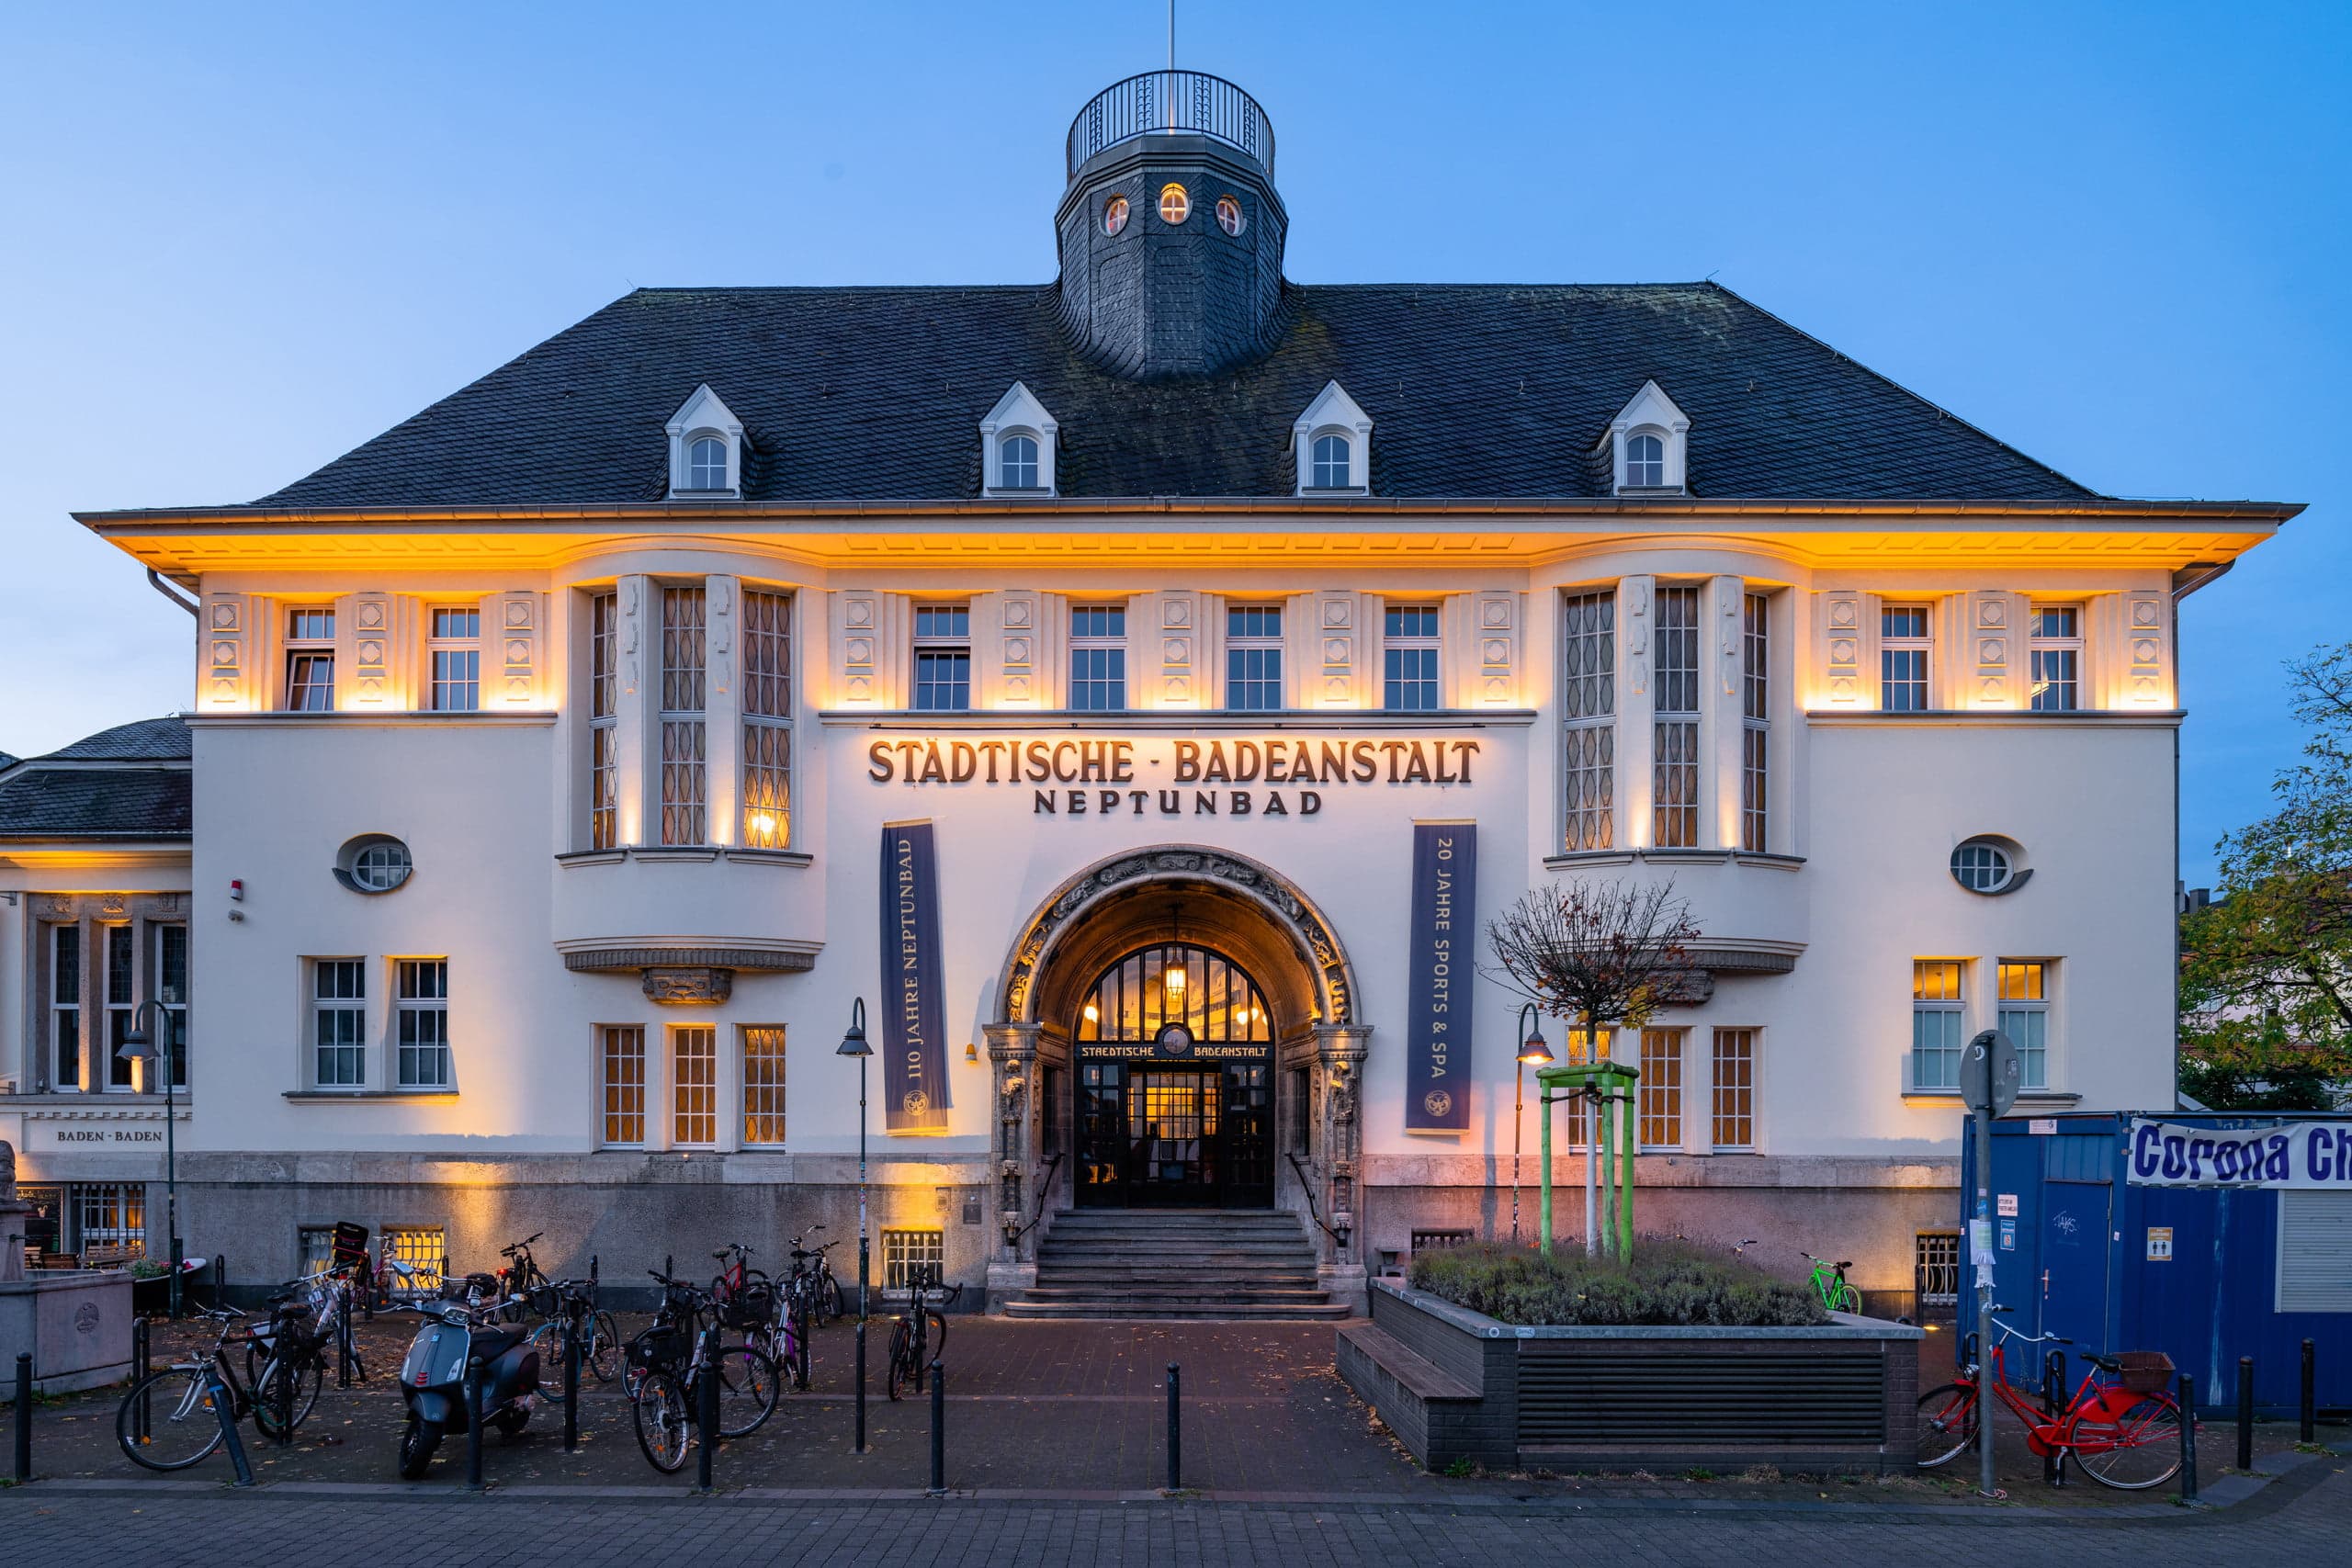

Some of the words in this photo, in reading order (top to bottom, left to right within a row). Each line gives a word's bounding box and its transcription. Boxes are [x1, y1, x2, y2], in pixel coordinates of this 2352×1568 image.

[868, 737, 1134, 784] STÄDTISCHE
[1174, 740, 1479, 783] BADEANSTALT
[1034, 790, 1323, 815] NEPTUNBAD
[1437, 838, 1453, 861] 20
[899, 840, 918, 970] NEPTUNBAD
[1435, 869, 1452, 931] JAHRE
[1433, 940, 1450, 1013] SPORTS
[904, 976, 924, 1045] JAHRE
[1432, 1021, 1447, 1034] &
[908, 1052, 922, 1080] 110
[1082, 1047, 1154, 1056] STAEDTISCHE
[1194, 1047, 1267, 1057] BADEANSTALT
[1431, 1043, 1447, 1078] SPA
[58, 1131, 104, 1141] BADEN
[115, 1131, 163, 1142] BADEN
[2134, 1124, 2290, 1181] Corona
